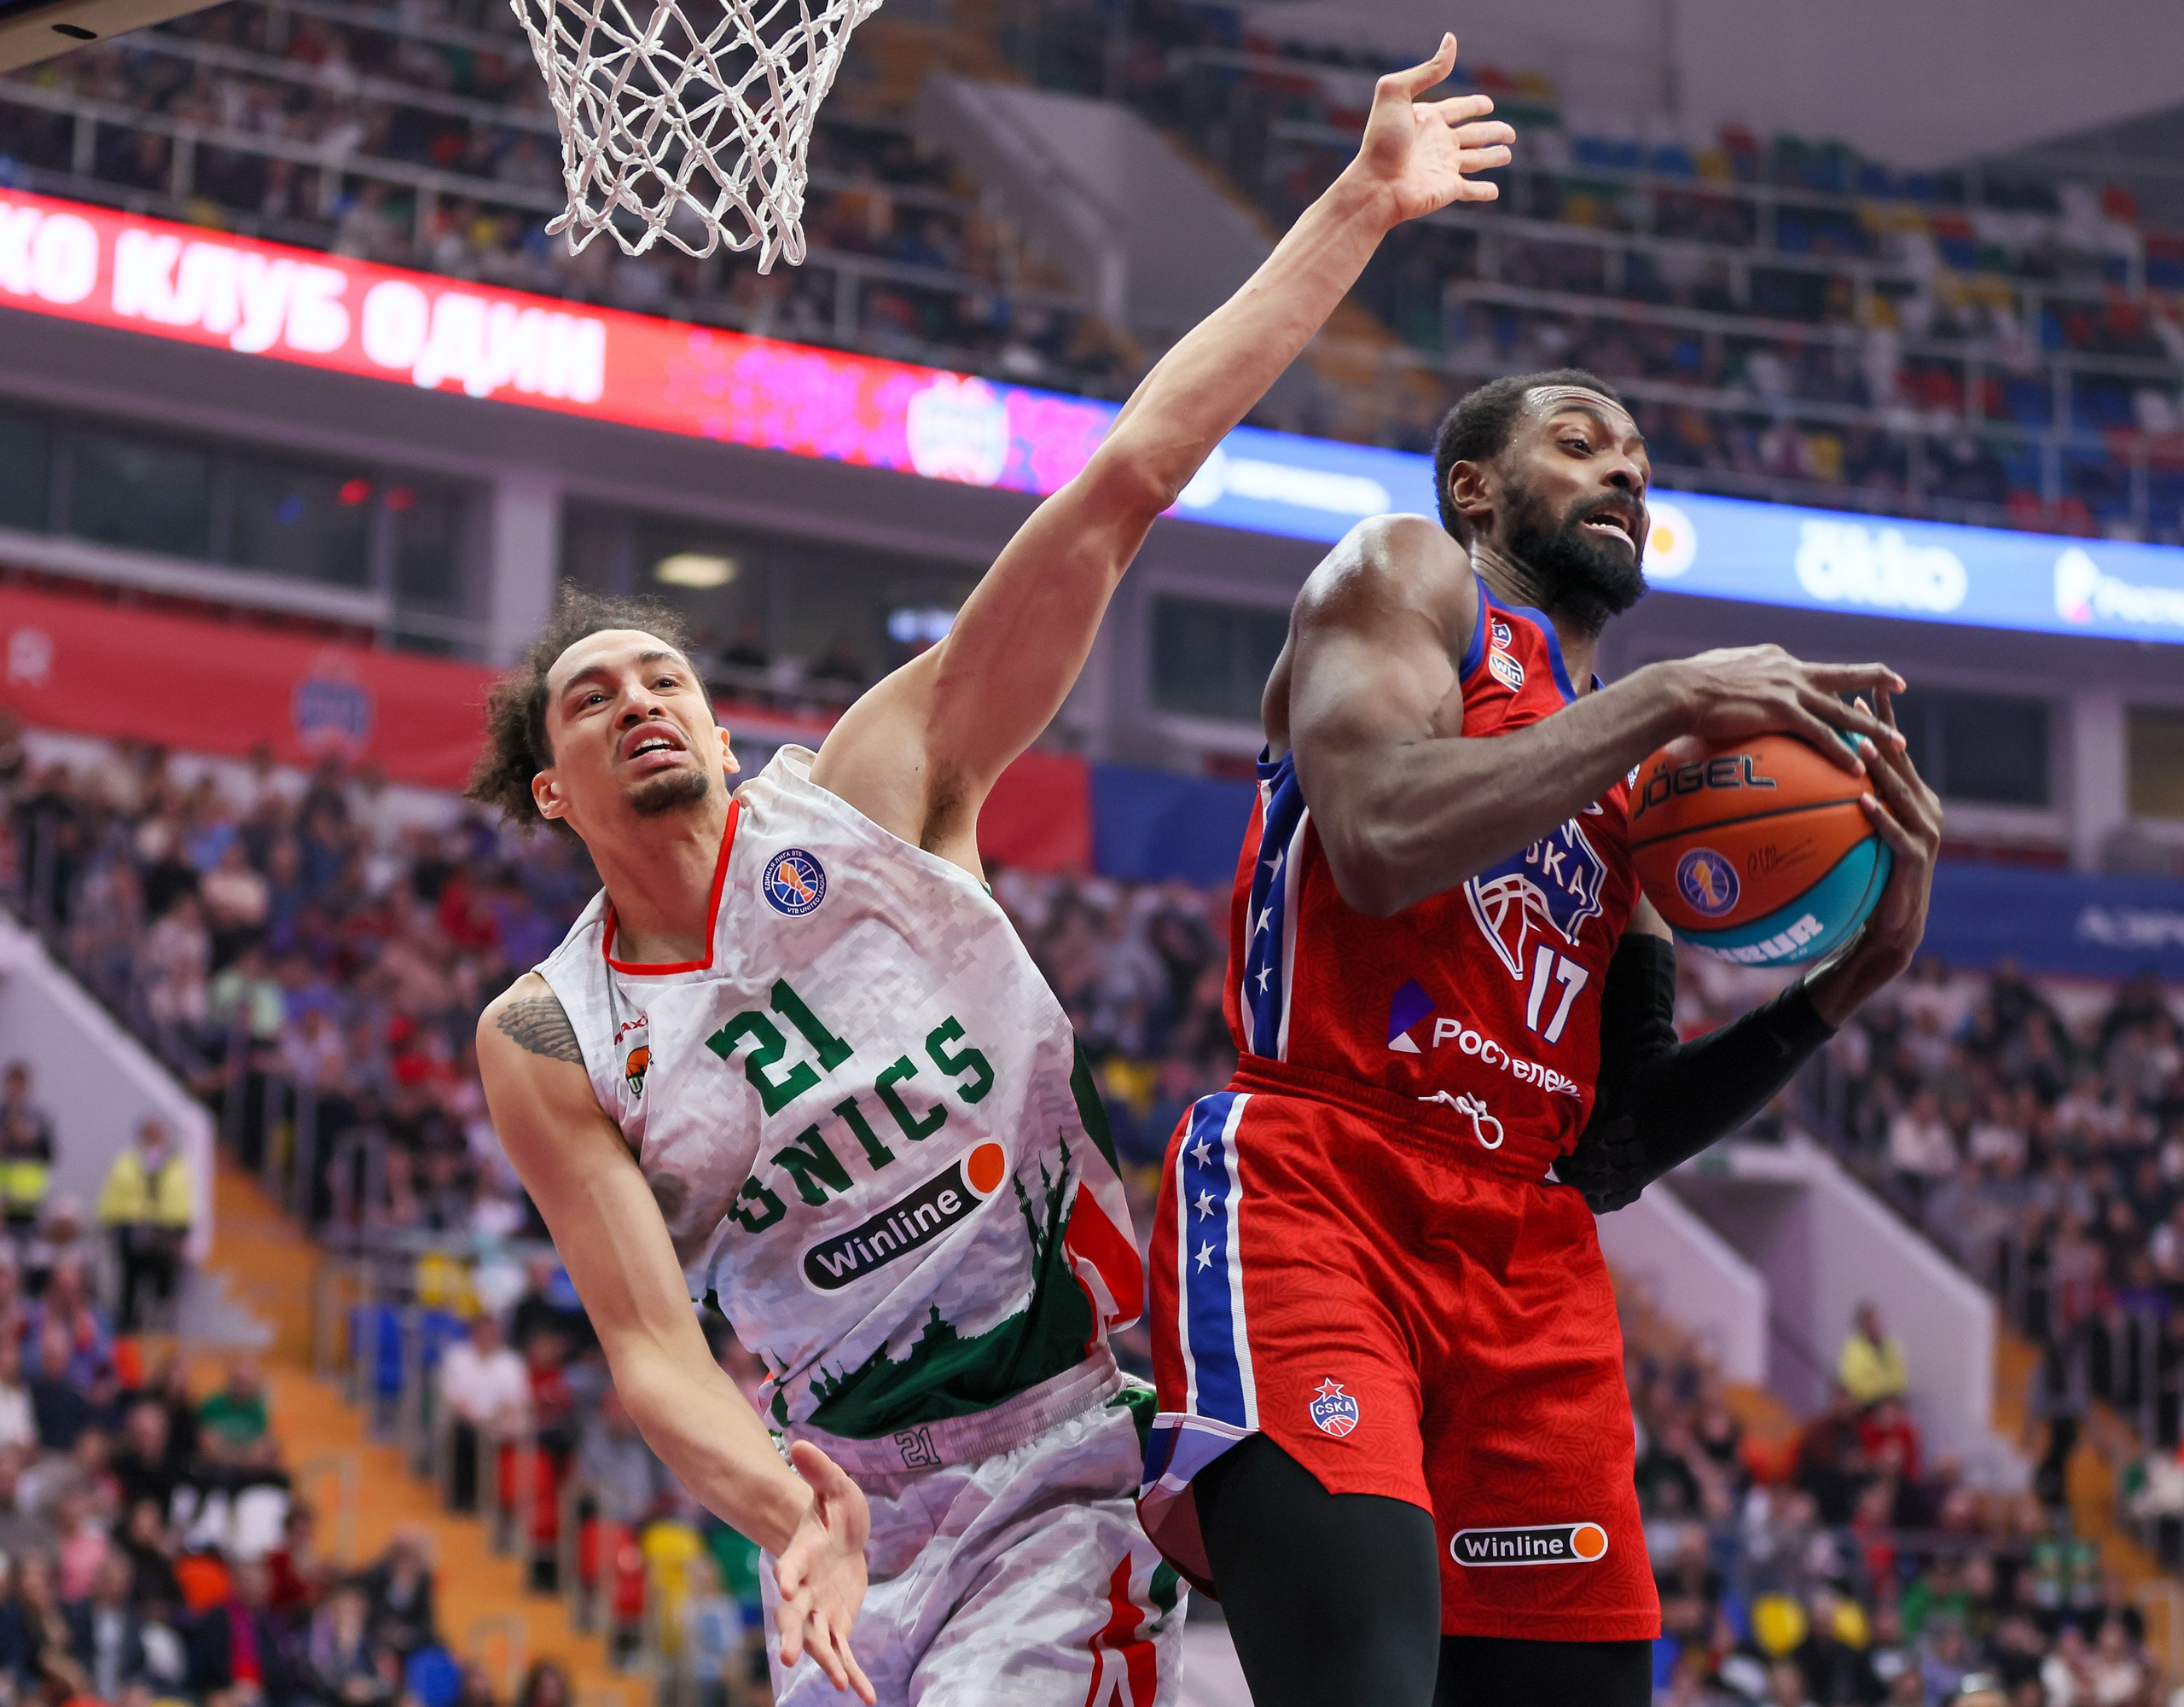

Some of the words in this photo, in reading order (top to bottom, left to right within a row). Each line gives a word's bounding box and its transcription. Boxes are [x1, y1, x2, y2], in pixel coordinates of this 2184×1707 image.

[112, 228, 350, 353] КЛУБ
[363, 281, 606, 404] ОДИН
[1634, 755, 1777, 821] JÖGEL
[764, 862, 775, 891] ЕДИНАЯ
[775, 851, 791, 863] ЛИГА
[799, 898, 820, 914] UNITED
[1527, 943, 1589, 1045] 17
[705, 978, 854, 1118] 21
[727, 1014, 995, 1234] UNICS
[816, 1189, 962, 1278] Winline
[1315, 1401, 1355, 1416] CSKA
[893, 1426, 942, 1468] 21
[1464, 1536, 1564, 1558] Winline
